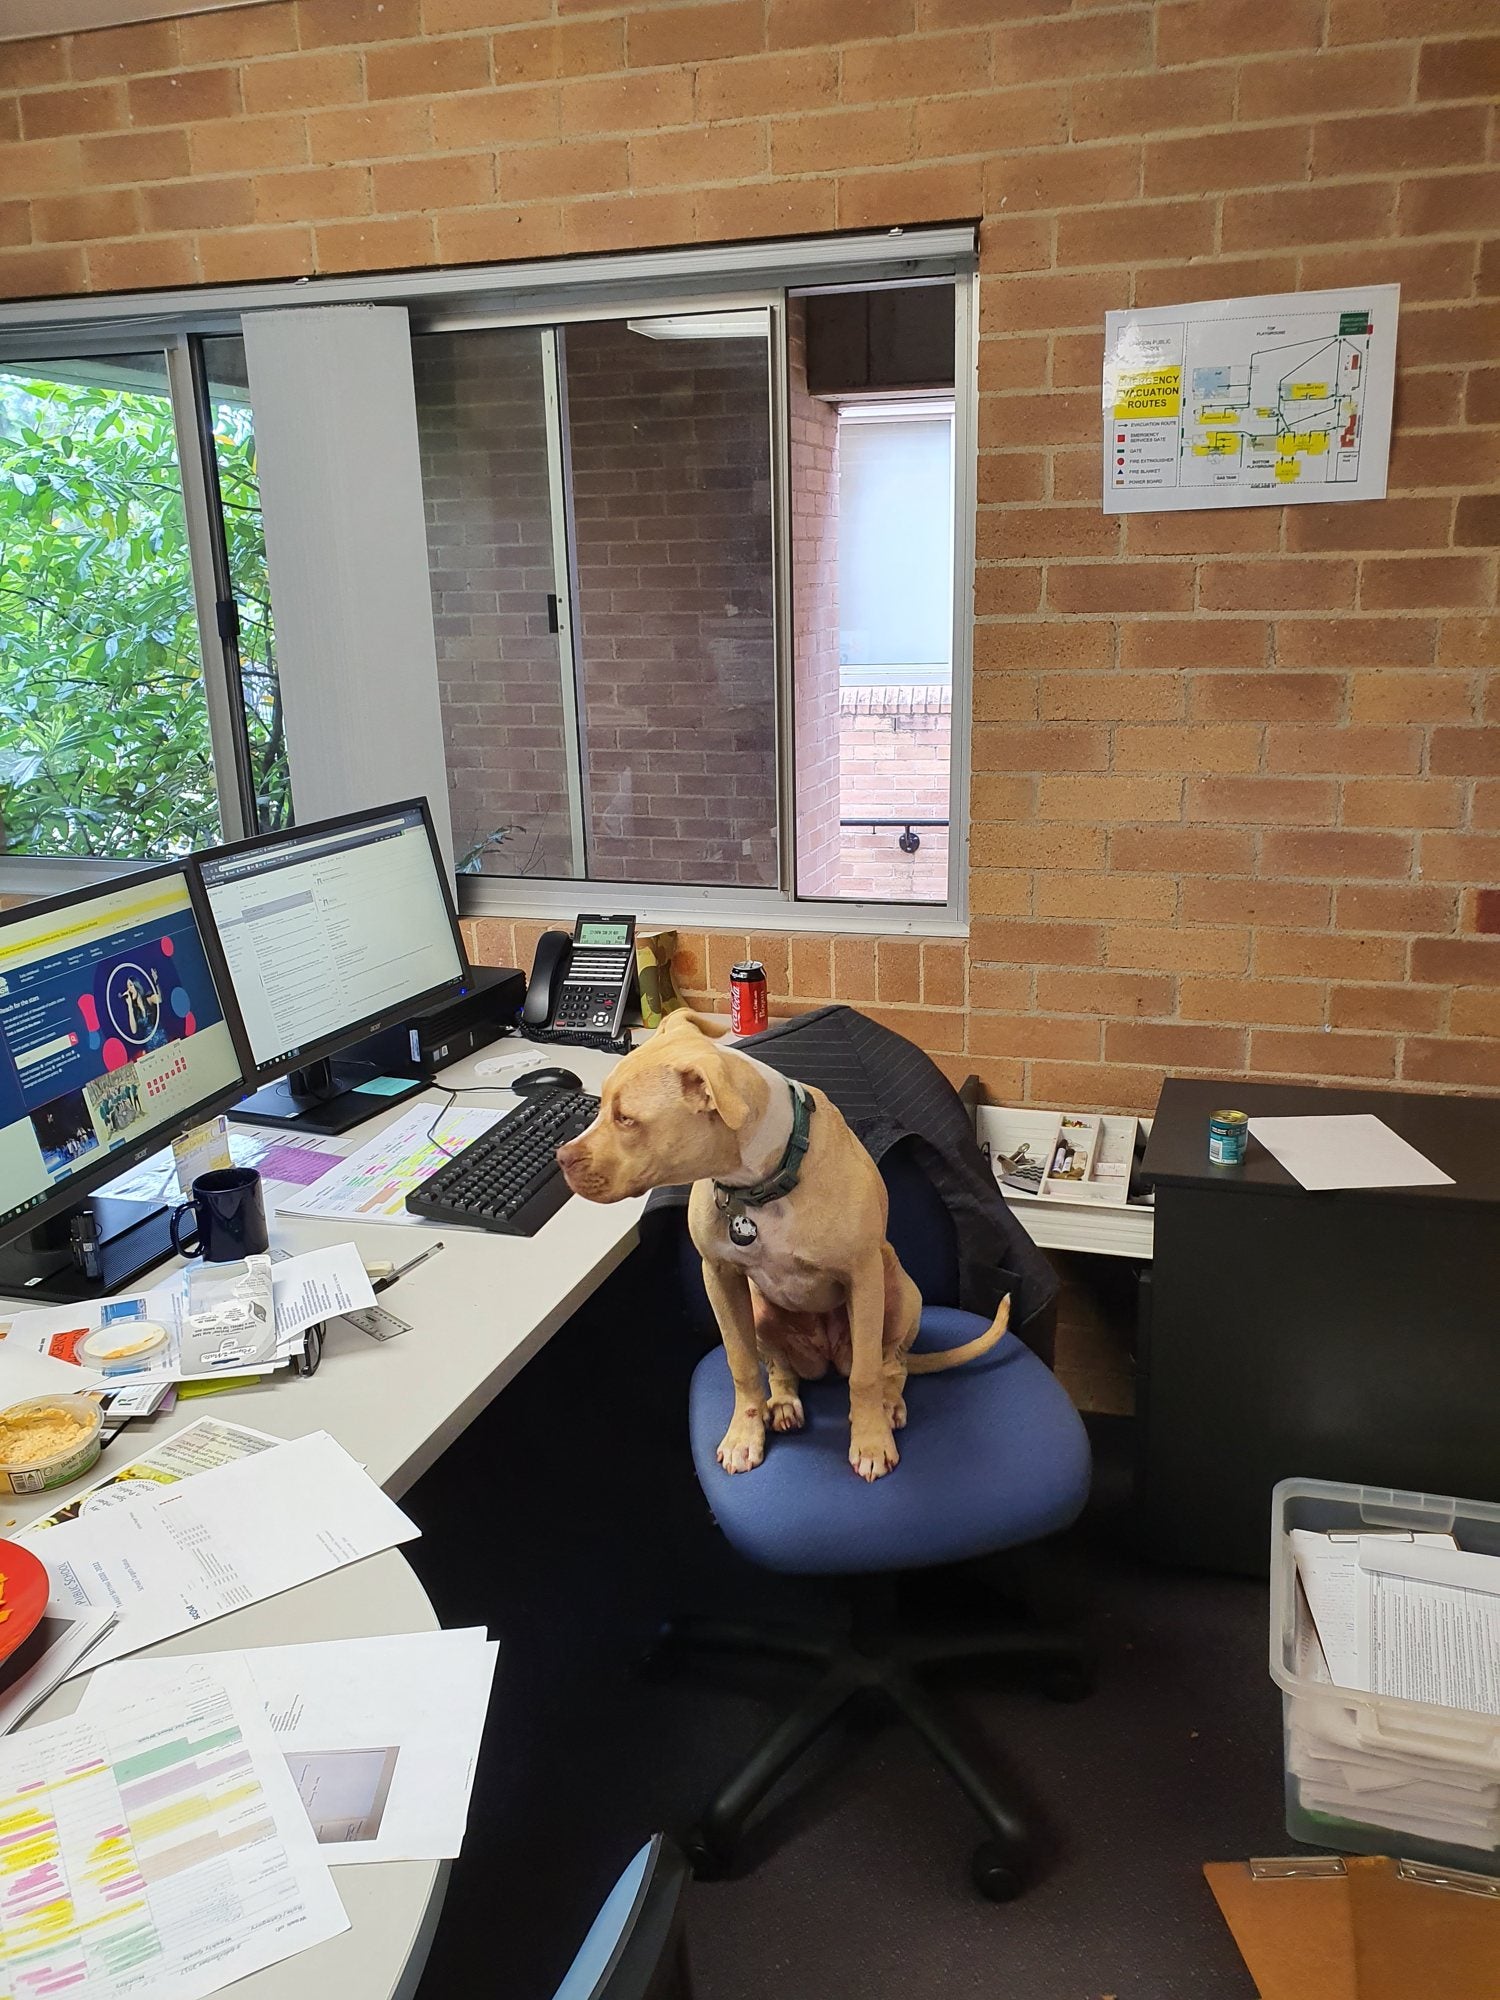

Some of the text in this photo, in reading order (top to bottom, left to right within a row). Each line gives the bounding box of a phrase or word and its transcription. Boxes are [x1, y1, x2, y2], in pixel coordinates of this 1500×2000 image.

[1119, 375, 1180, 387] EMERGENCY
[1117, 387, 1179, 399] EVACUATION
[1127, 399, 1167, 409] ROUTES
[134, 1148, 149, 1161] acer
[55, 1562, 87, 1607] PUBLIC SCHOOL
